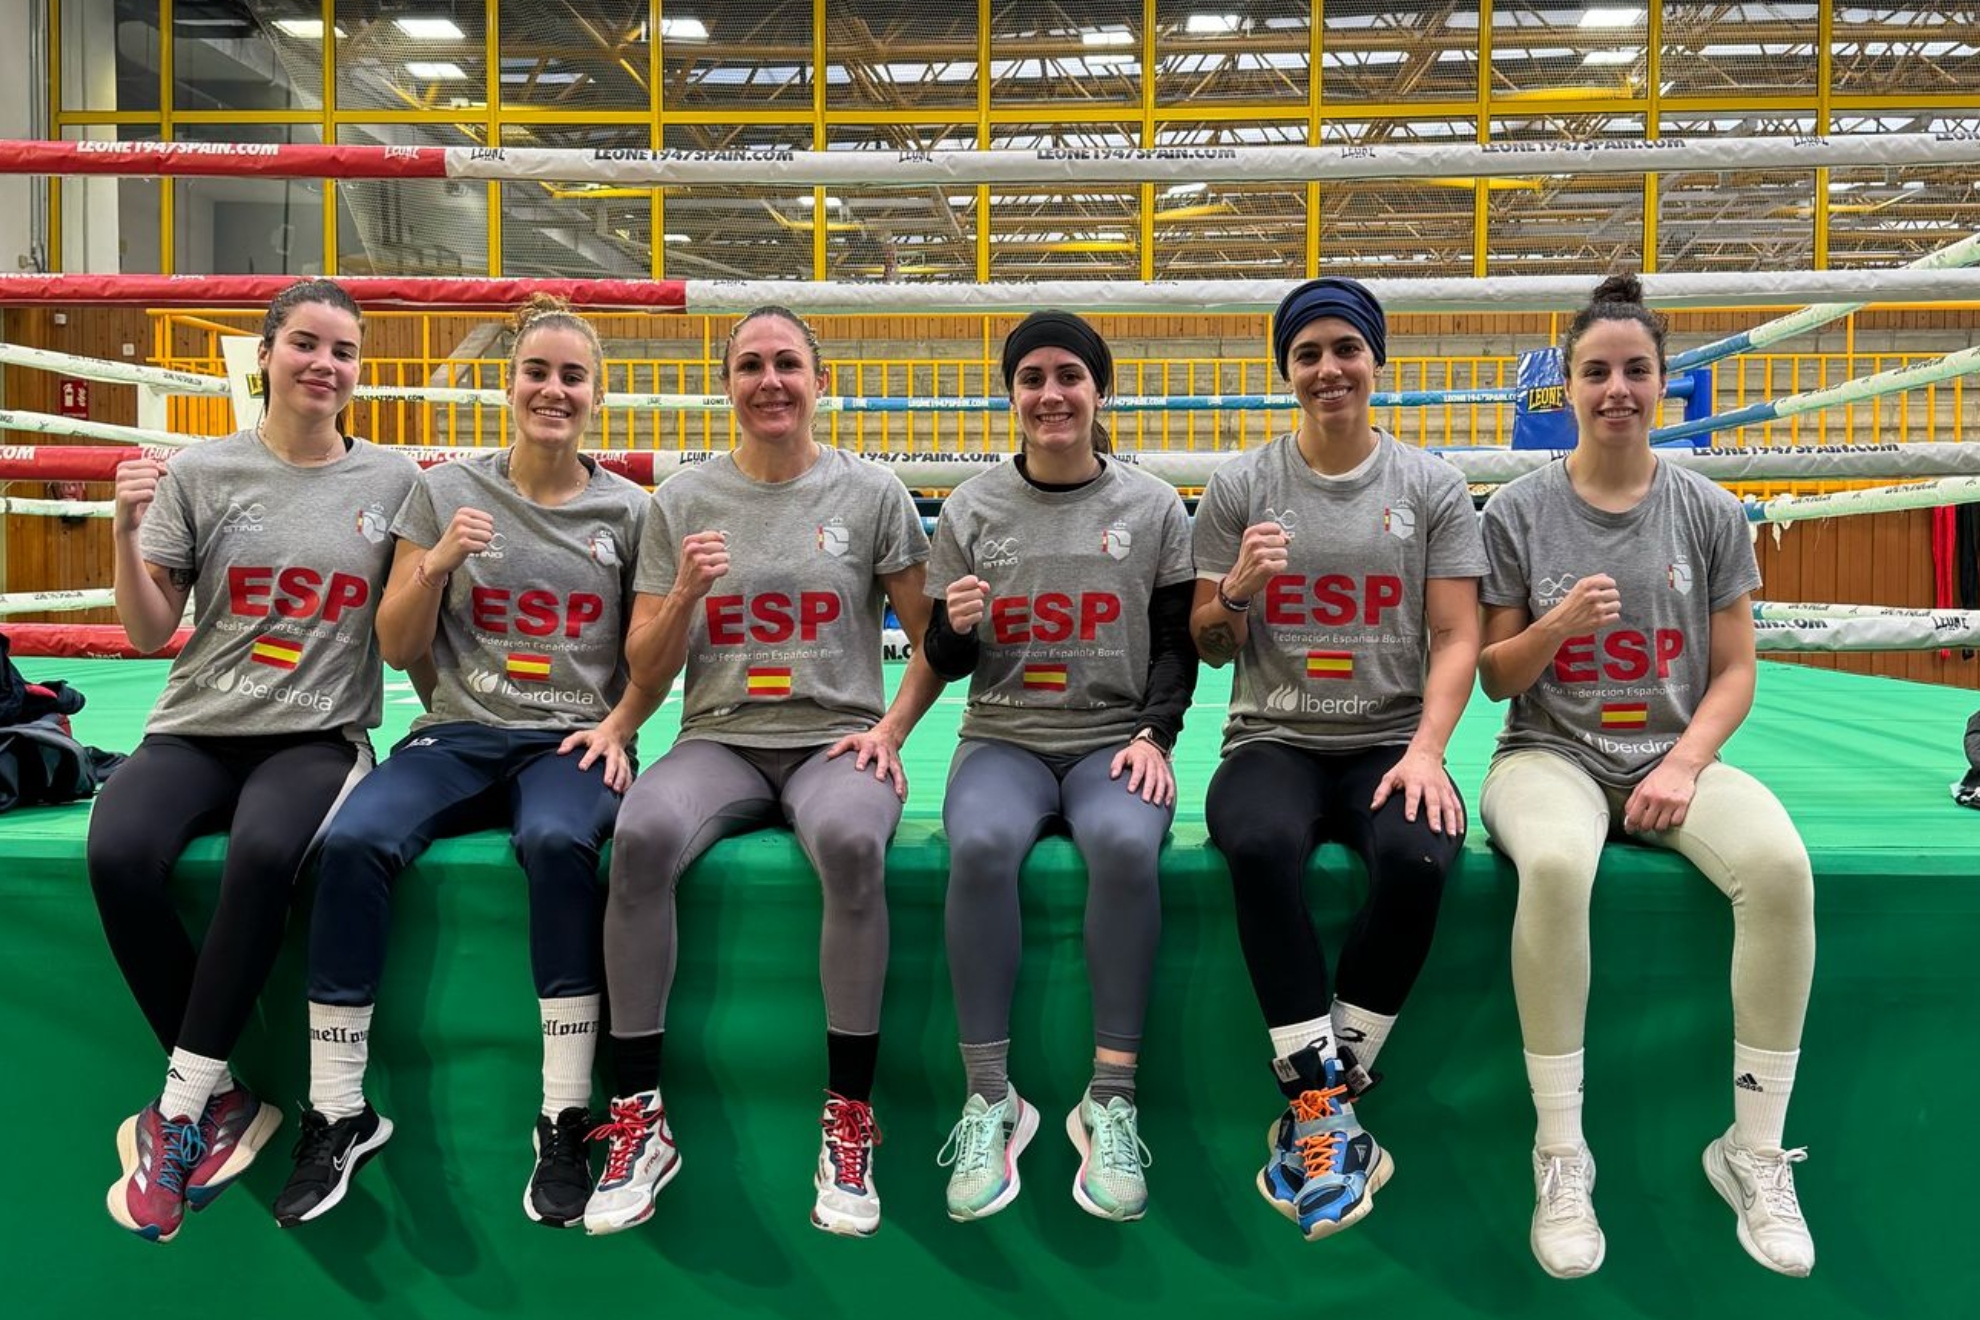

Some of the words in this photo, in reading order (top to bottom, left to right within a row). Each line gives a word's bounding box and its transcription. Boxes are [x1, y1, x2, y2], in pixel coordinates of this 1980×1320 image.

[1528, 385, 1563, 410] LEONE
[228, 566, 369, 624] ESP
[472, 586, 603, 639] ESP
[705, 592, 841, 645] ESP
[991, 592, 1121, 644] ESP
[1265, 574, 1403, 626] ESP
[1554, 628, 1684, 682] ESP
[239, 675, 333, 711] Iberdrola
